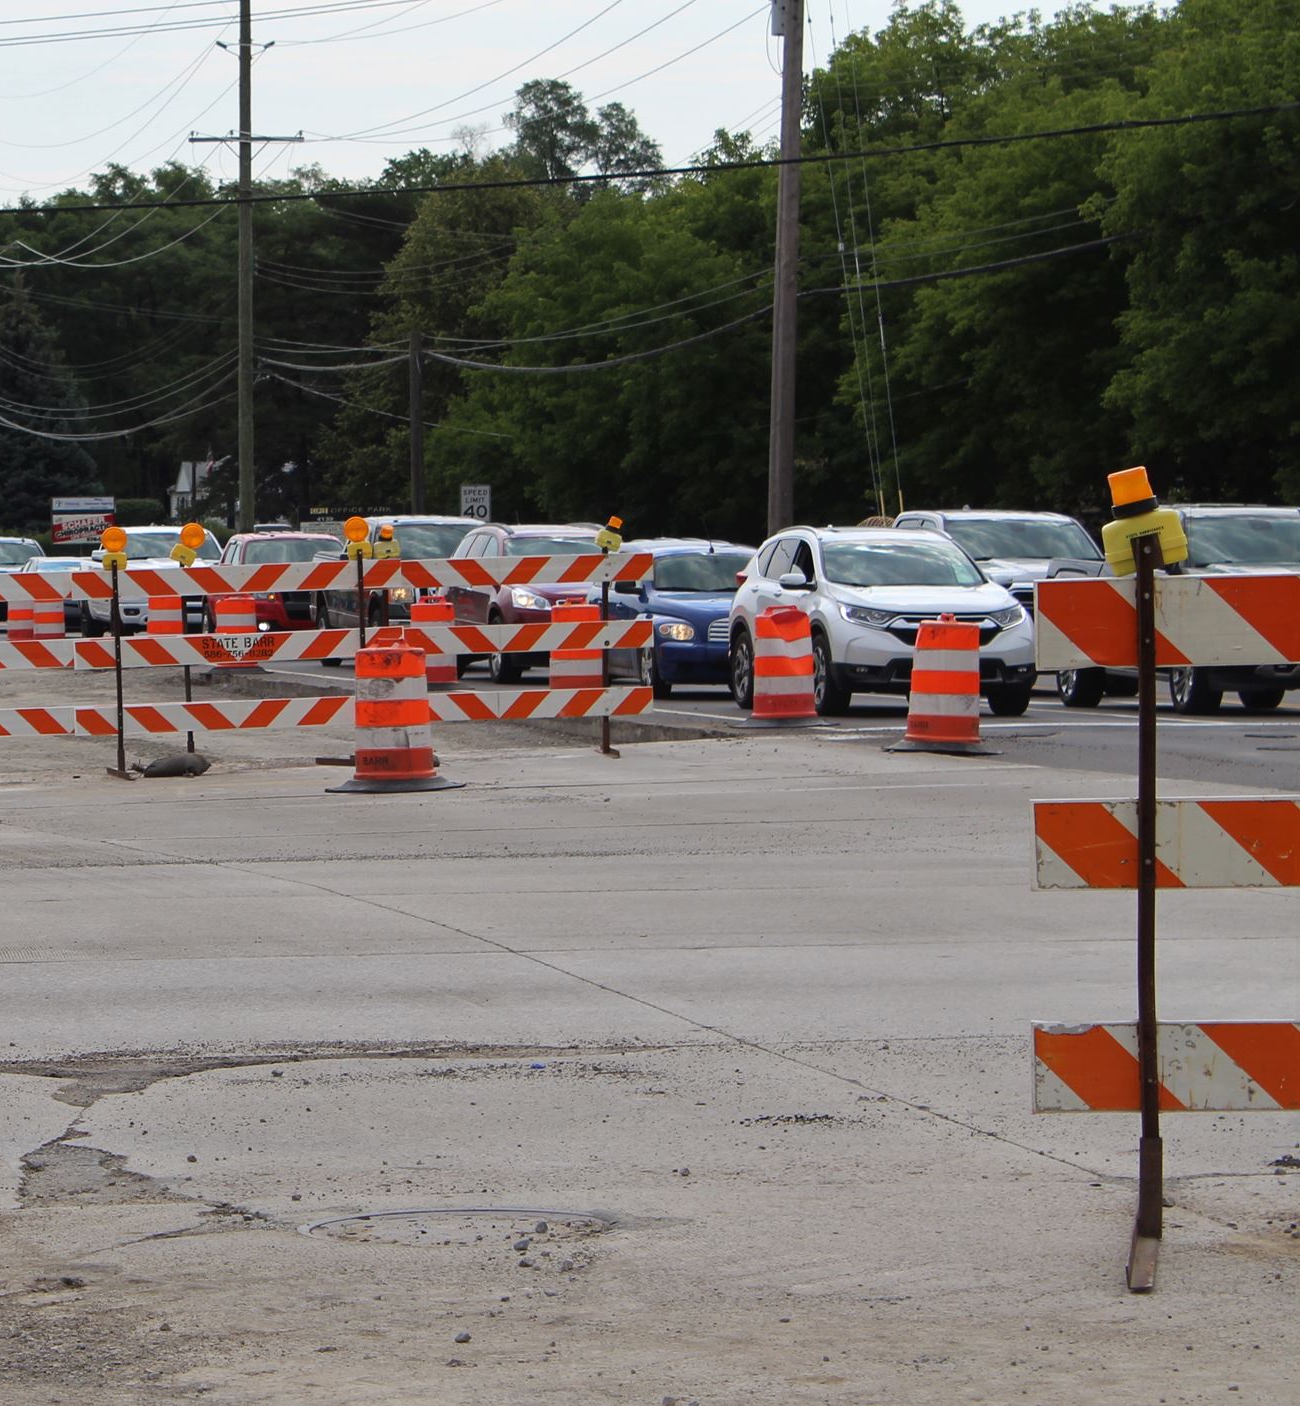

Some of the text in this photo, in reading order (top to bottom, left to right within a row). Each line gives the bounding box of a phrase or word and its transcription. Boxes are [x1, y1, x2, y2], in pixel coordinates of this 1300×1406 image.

[330, 506, 364, 514] OFFICE
[463, 504, 488, 518] 40
[202, 636, 275, 650] STATE BARR
[362, 755, 389, 766] BARR
